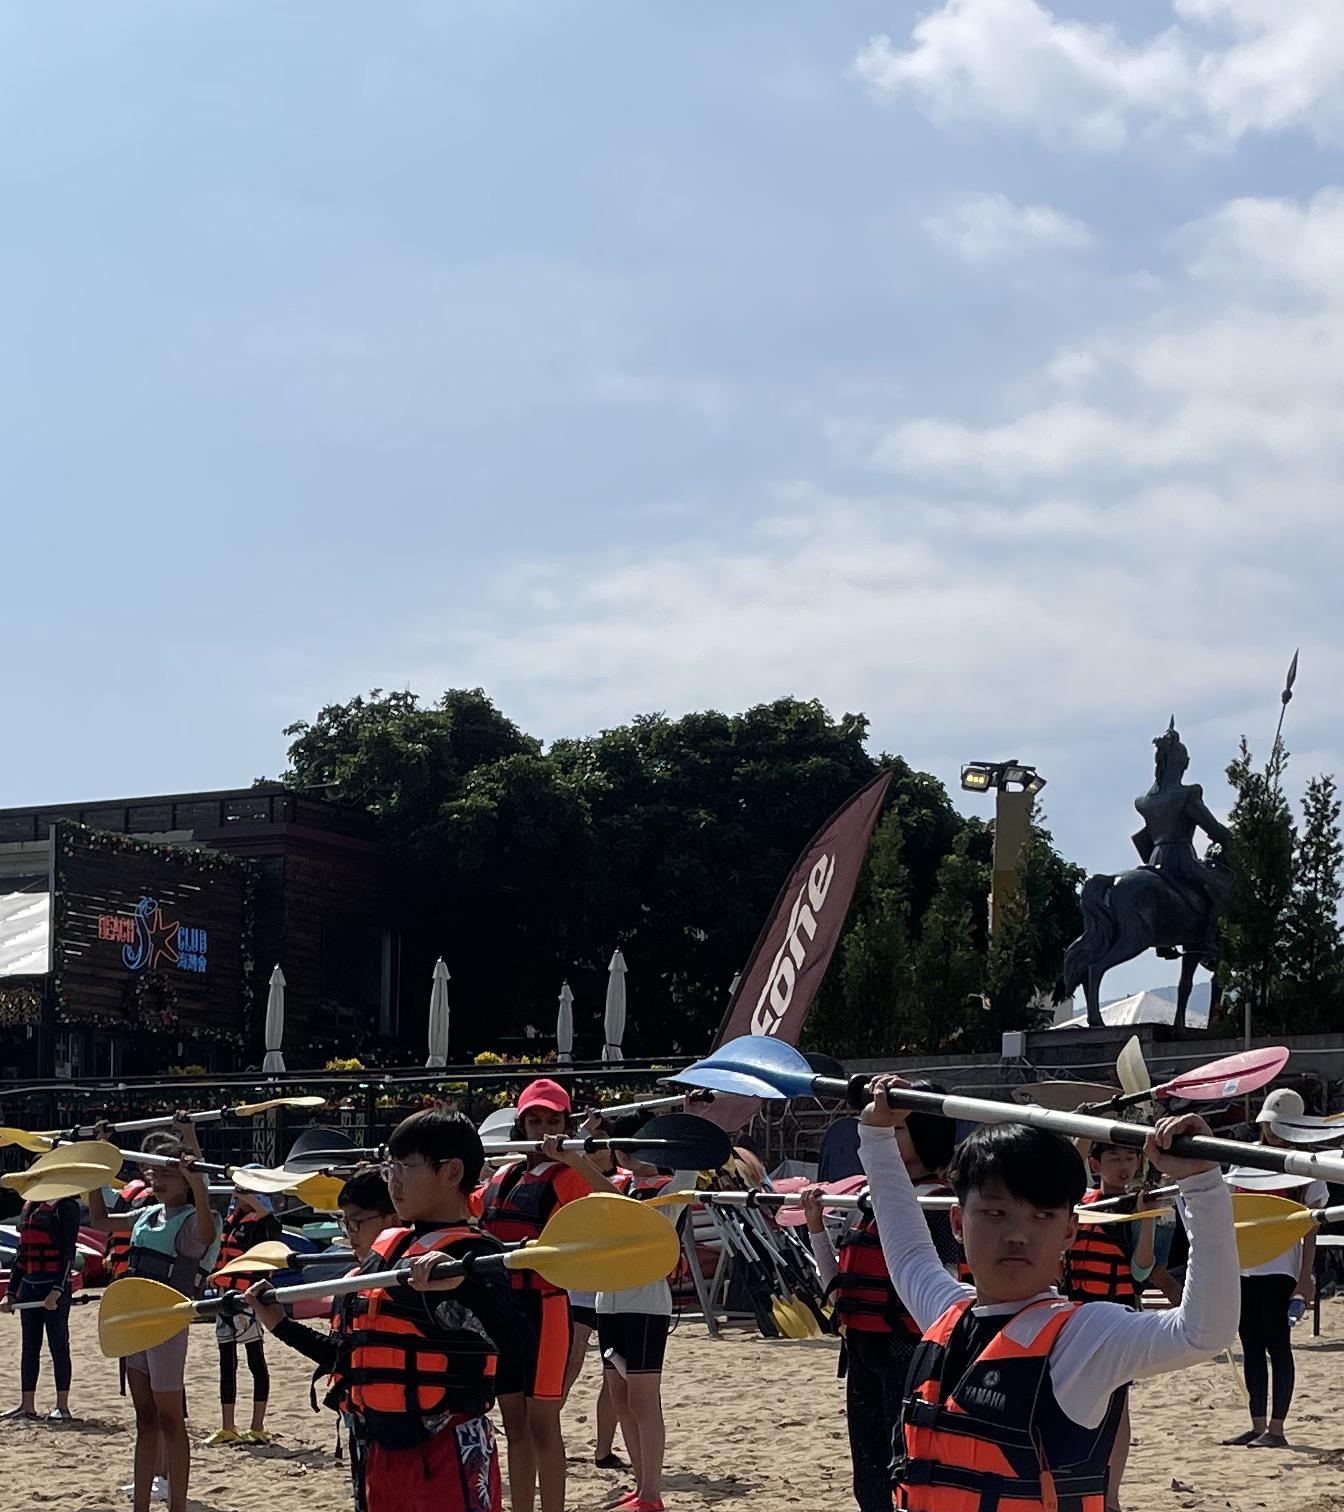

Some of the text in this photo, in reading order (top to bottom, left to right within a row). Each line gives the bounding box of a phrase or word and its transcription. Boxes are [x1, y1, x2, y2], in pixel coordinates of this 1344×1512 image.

[98, 914, 207, 954] BEACH CLUB
[964, 1385, 1006, 1411] YAMAHA
